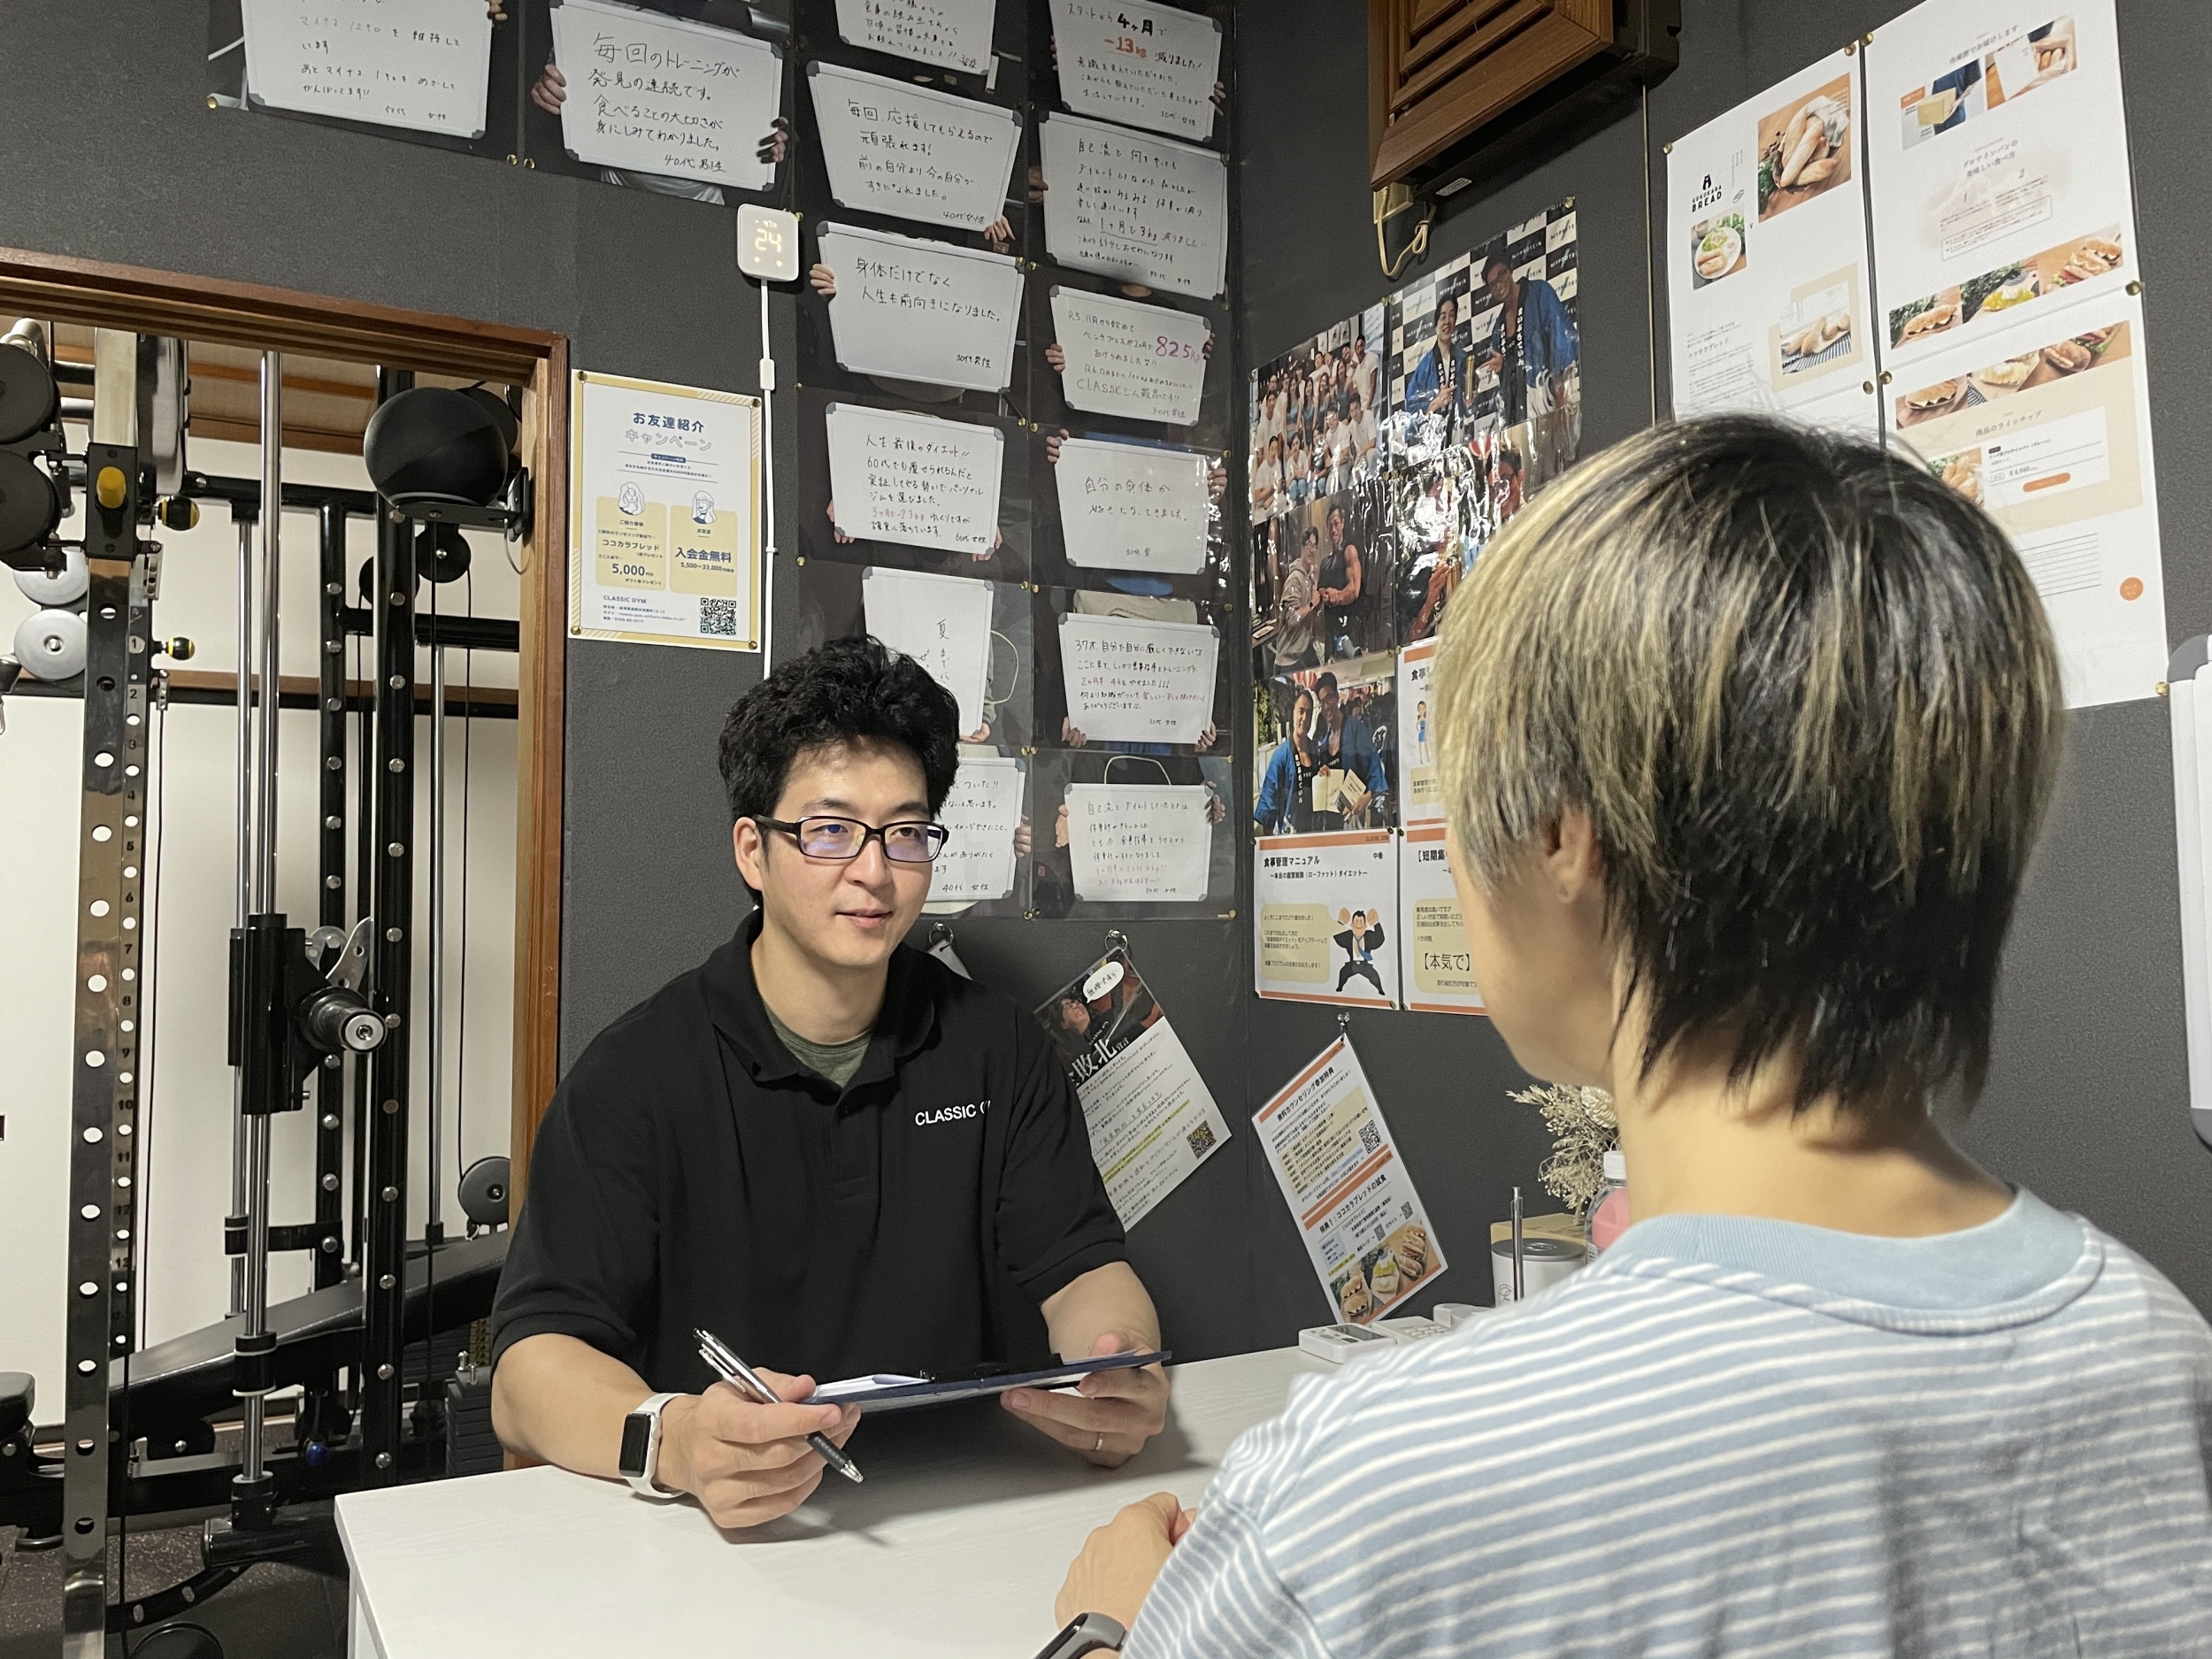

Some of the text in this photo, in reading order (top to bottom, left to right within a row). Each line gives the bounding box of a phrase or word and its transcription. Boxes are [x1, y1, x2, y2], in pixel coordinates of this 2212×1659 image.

[593, 32, 741, 78] 毎回のトレーニングが
[588, 69, 711, 101] 発見の連続です。
[594, 94, 724, 130] 食べることの大切さが
[2019, 168, 2024, 178] 2
[1692, 191, 1722, 212] BREAD
[755, 228, 781, 252] 24
[856, 257, 951, 288] 身体だけでなく
[862, 286, 1001, 322] 人生も前向きになりました。
[633, 411, 704, 434] お友達紹介
[625, 429, 711, 451] キャンペーン
[603, 539, 659, 550] ココカラブレッド
[675, 547, 732, 563] 入会金無料
[132, 638, 136, 649] 1
[129, 689, 137, 699] 2
[128, 740, 136, 749] 3
[127, 841, 134, 851] 5
[1418, 849, 1448, 862] 【短期集
[1263, 856, 1320, 868] 食事管理マニュアル
[126, 892, 134, 902] 6
[125, 944, 133, 954] 7
[1424, 953, 1471, 972] 【本気で】
[122, 995, 131, 1006] 8
[122, 1048, 130, 1058] 9
[118, 1099, 134, 1110] 10
[915, 1104, 977, 1125] CLASSIC
[117, 1151, 130, 1163] 11
[117, 1204, 130, 1215] 12
[115, 1257, 128, 1268] 13
